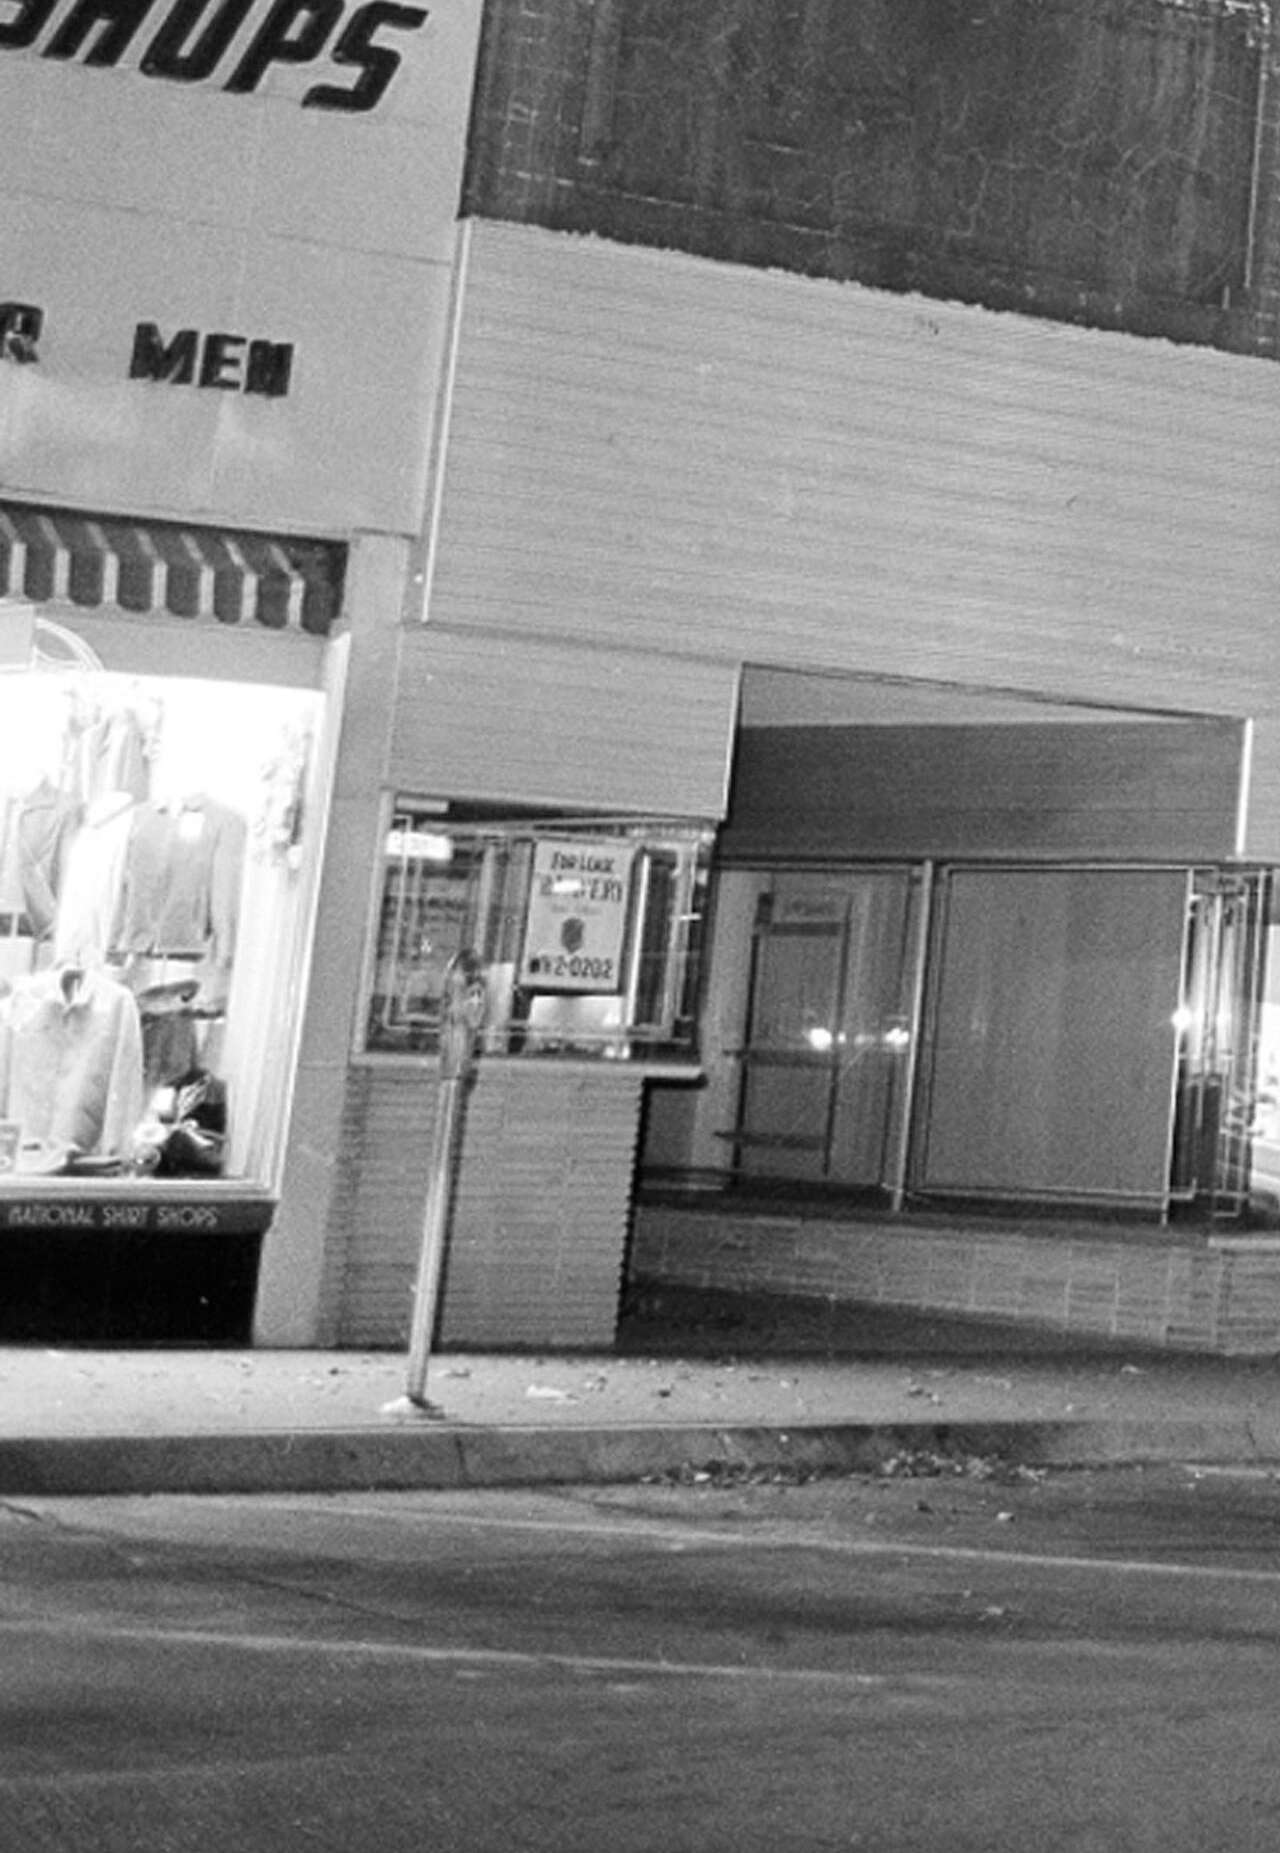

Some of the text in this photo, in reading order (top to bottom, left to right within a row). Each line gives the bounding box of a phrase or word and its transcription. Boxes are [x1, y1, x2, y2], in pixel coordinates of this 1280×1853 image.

[129, 322, 294, 398] MEN
[7, 1205, 96, 1227] NATIONAL
[156, 1206, 219, 1229] SHOPS
